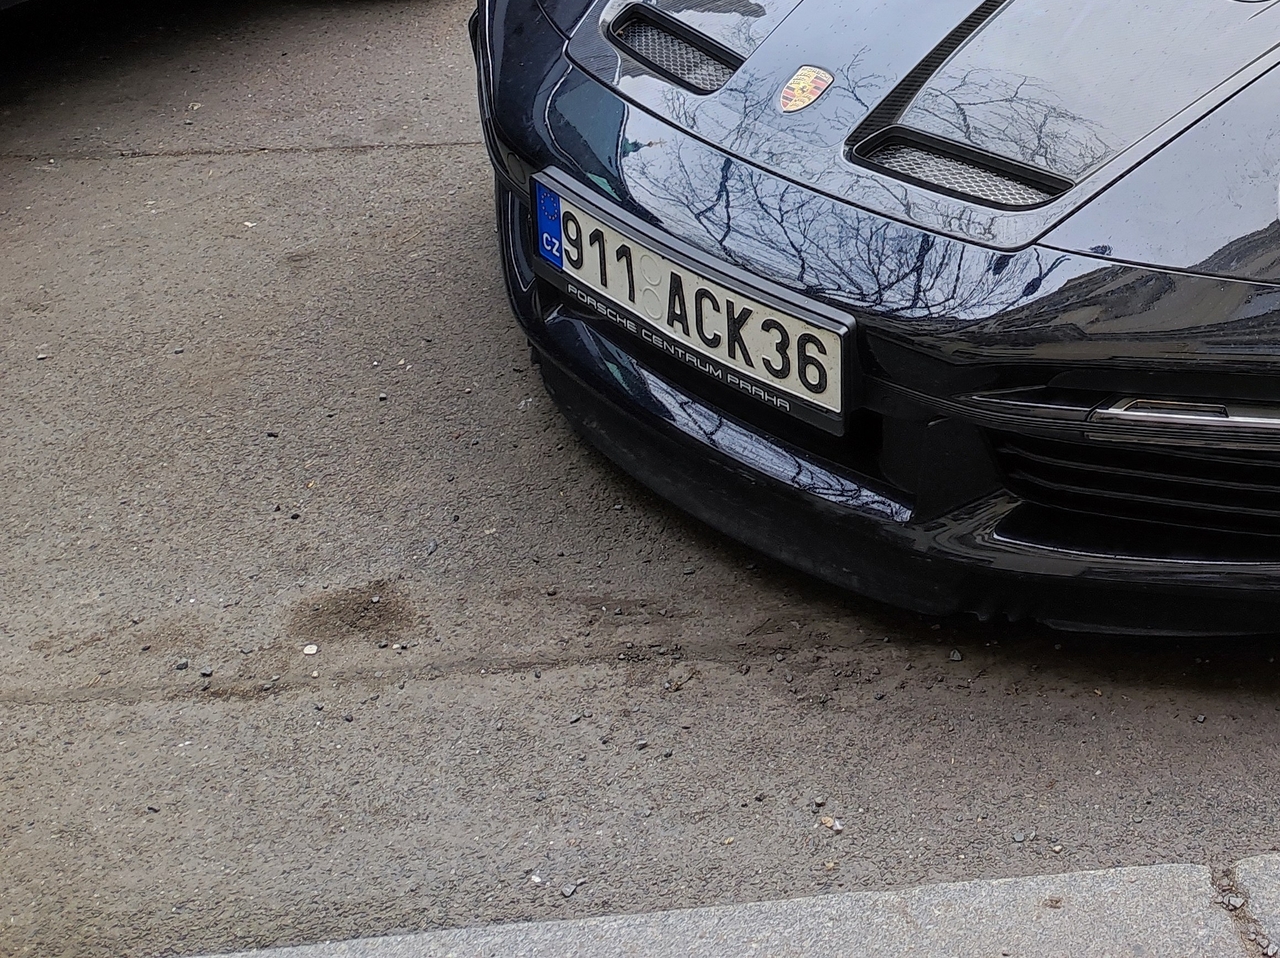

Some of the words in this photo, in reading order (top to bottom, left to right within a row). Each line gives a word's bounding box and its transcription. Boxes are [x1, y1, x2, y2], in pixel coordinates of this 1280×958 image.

[542, 231, 561, 258] CZ
[562, 209, 636, 303] 911
[666, 270, 828, 395] ACK36
[567, 283, 638, 335] PORSCHE
[641, 327, 723, 380] CENTRUM
[727, 372, 791, 413] PRAHA
